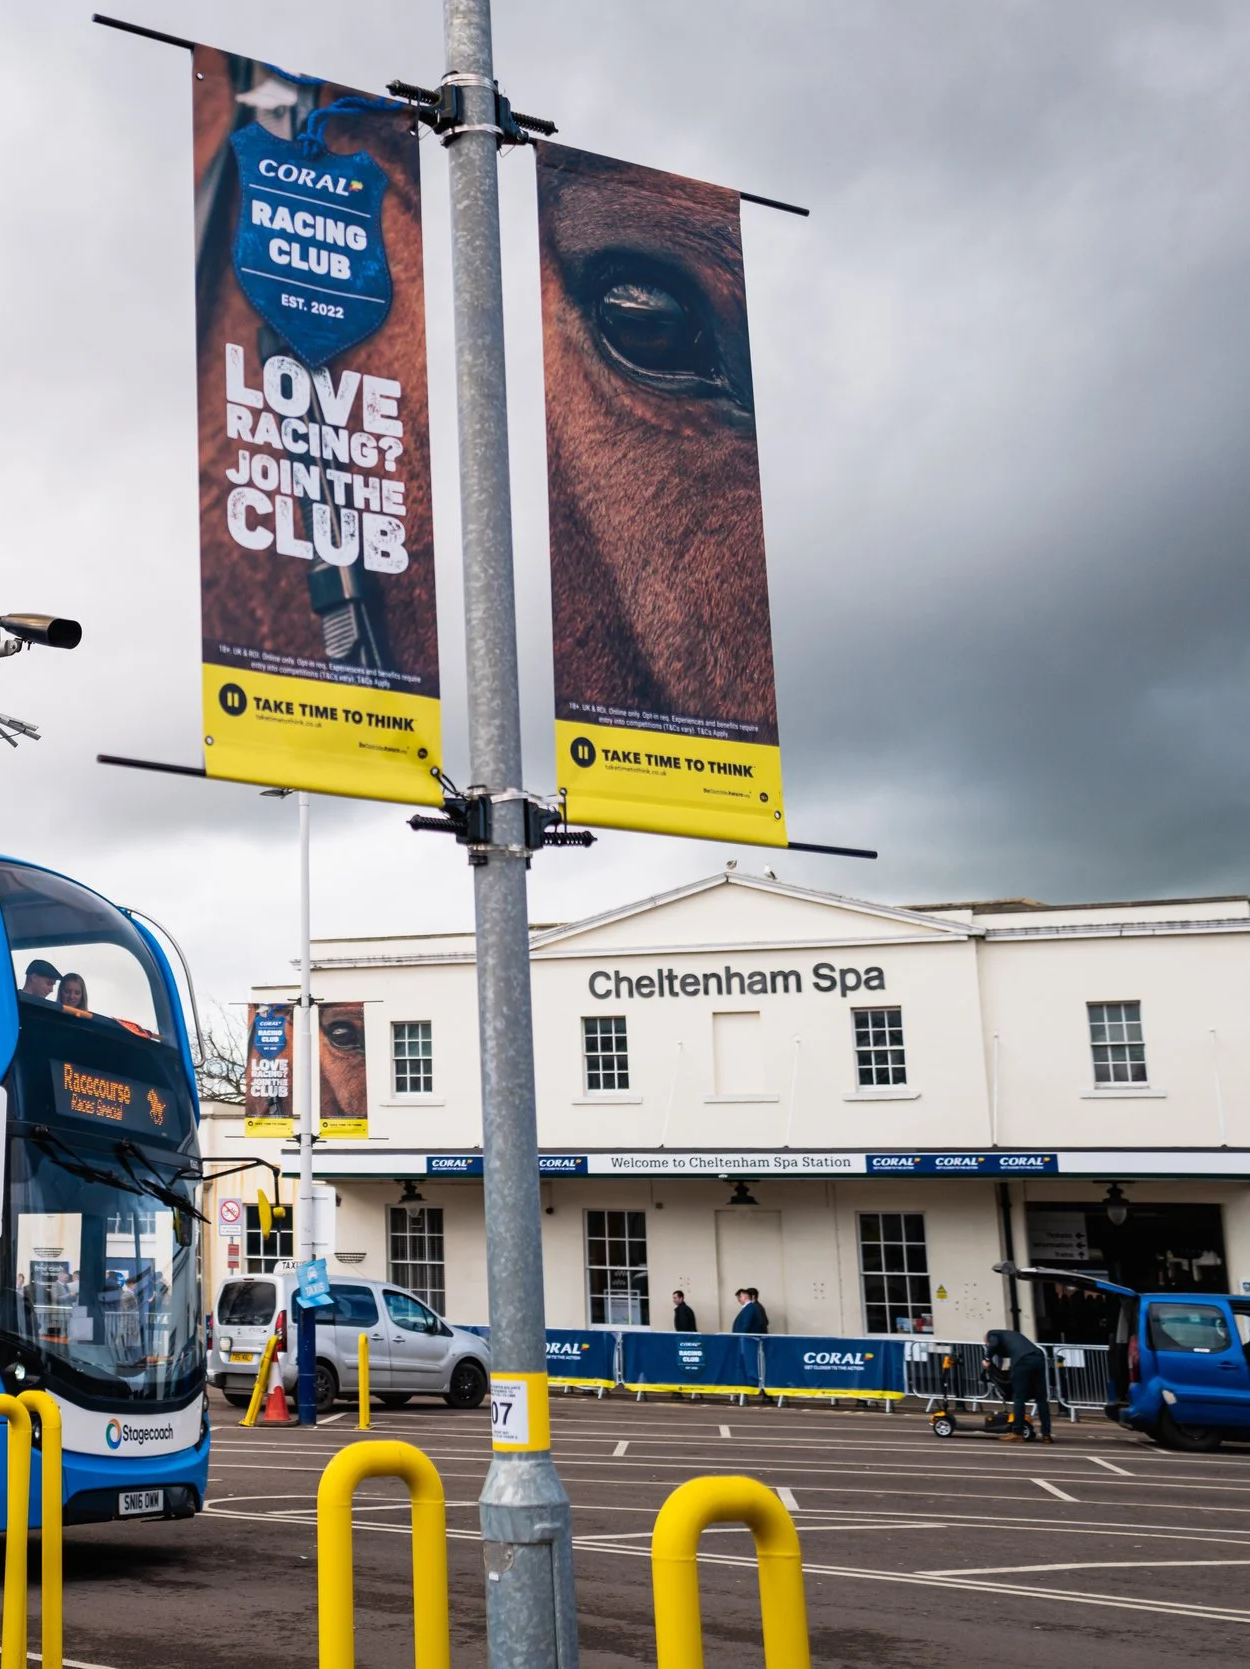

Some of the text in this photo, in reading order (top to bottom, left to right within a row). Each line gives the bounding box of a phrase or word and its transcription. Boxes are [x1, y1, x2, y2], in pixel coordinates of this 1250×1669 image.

[258, 158, 350, 196] CORAL
[251, 199, 367, 251] RACING
[269, 238, 351, 280] CLUB
[281, 293, 345, 319] EST. 2022
[225, 342, 404, 437] LOVE
[226, 402, 404, 472] RACING?
[225, 449, 407, 516] JOIN THE
[227, 486, 410, 575] CLUB
[253, 696, 415, 732] TAKE TIME TO THINK
[581, 704, 591, 712] UK
[591, 704, 596, 713] &
[671, 715, 704, 726] Experiences
[716, 720, 739, 730] benefits
[739, 724, 759, 733] require
[625, 719, 662, 730] competitions
[601, 748, 754, 779] TAKE TIME TO THINK
[588, 962, 886, 1000] Cheltenham Spa
[251, 1058, 289, 1071] LOVE
[63, 1063, 131, 1105] Racecourse
[250, 1085, 289, 1098] CLUB
[431, 1159, 468, 1167] CORAL
[539, 1159, 576, 1167] CORAL
[611, 1156, 852, 1169] Welcome to Cheltenham Spa Station
[872, 1156, 1044, 1166] CORAL CORAL CORAL
[803, 1351, 865, 1365] CORAL
[122, 1424, 174, 1445] Stagecoach
